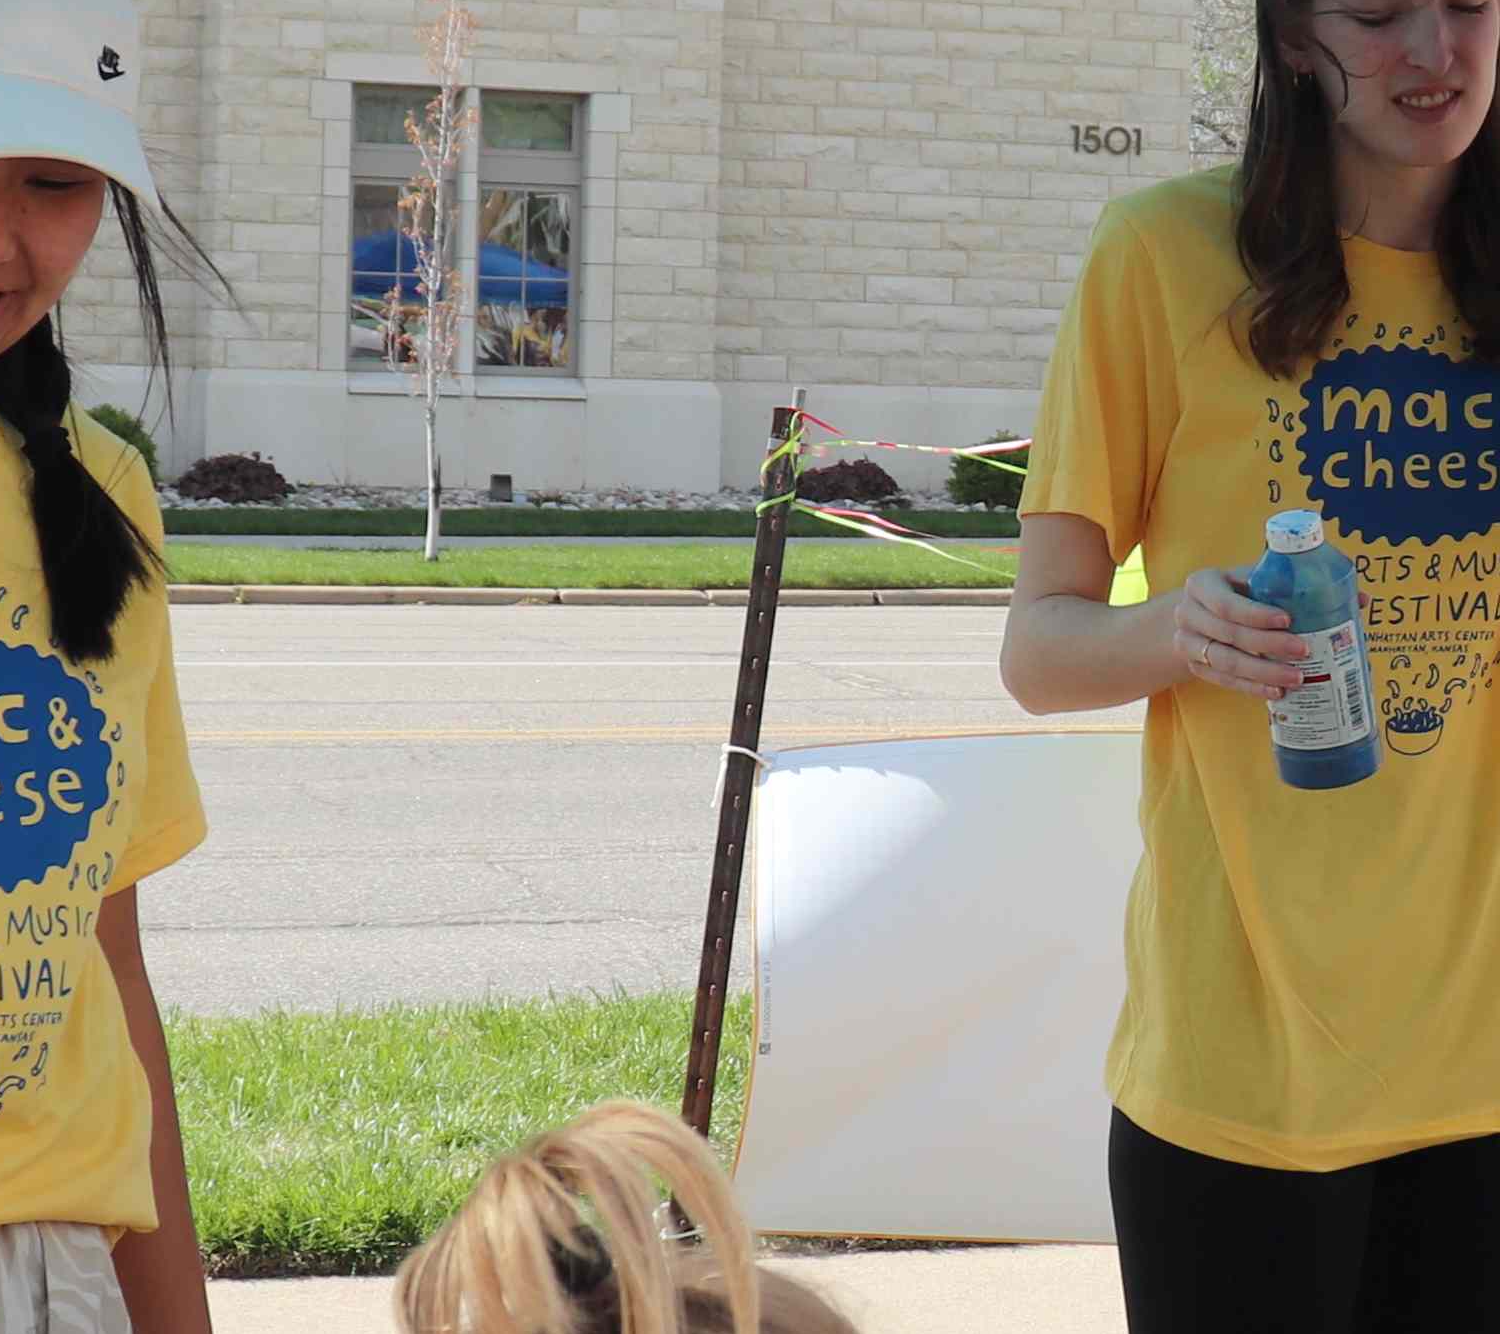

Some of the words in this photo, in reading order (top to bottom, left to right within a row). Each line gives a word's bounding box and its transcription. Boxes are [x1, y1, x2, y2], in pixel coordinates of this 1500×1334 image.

[1070, 125, 1143, 156] 1501
[1323, 386, 1493, 433] mac
[1356, 554, 1411, 585] RTS
[1425, 554, 1441, 580] &
[48, 697, 82, 749] &
